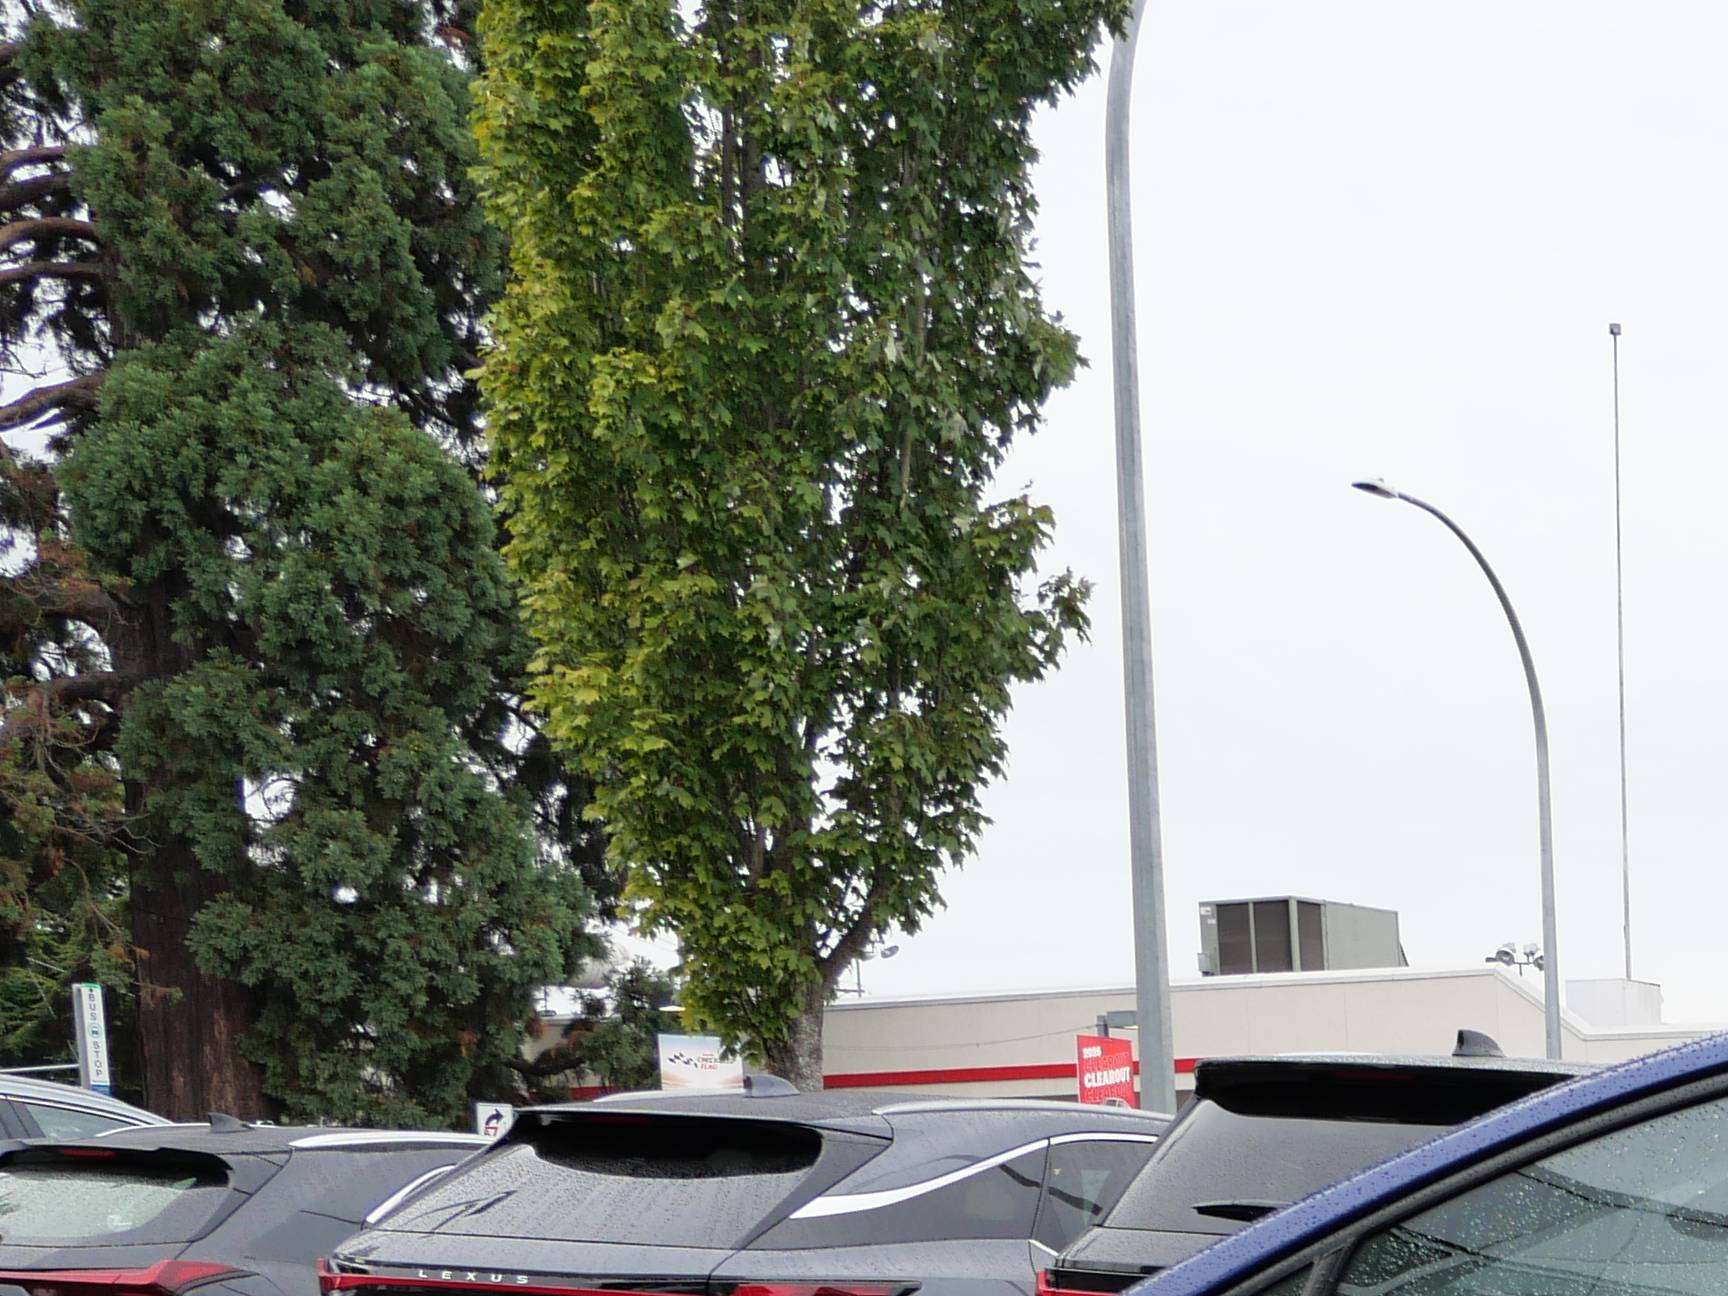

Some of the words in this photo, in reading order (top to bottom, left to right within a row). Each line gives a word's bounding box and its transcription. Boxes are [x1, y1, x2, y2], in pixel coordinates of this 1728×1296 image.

[88, 993, 97, 1021] BUS
[92, 1040, 103, 1076] STOP
[1084, 1066, 1130, 1088] CLEAROUT
[418, 1270, 529, 1285] LEXUS
